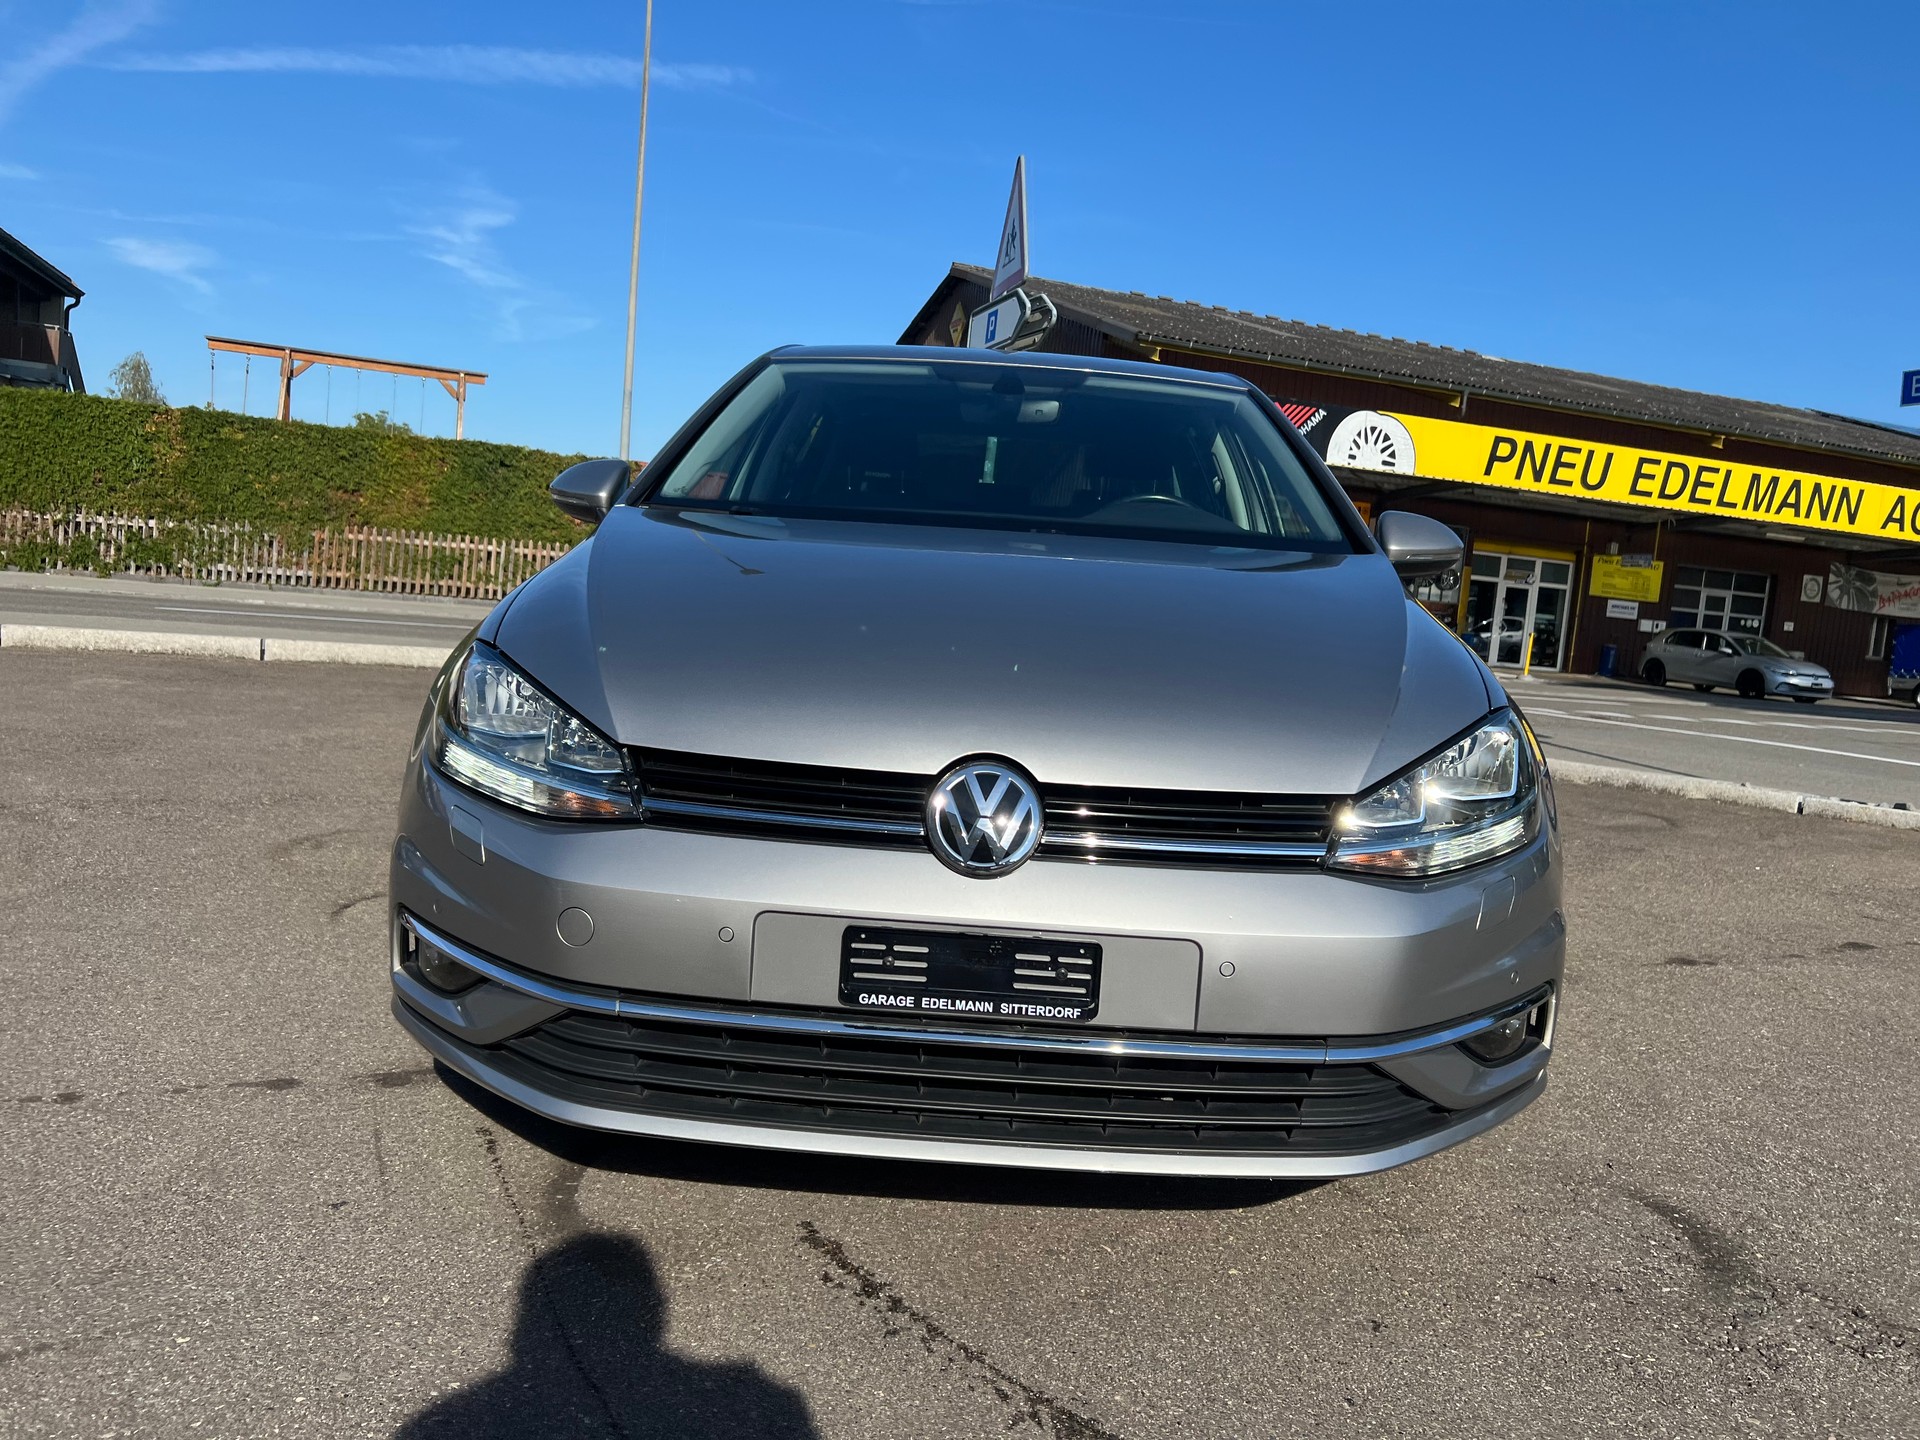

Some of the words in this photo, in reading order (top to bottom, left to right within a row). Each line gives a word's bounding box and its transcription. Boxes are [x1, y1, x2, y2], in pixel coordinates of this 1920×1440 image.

[987, 315, 996, 340] P
[1298, 408, 1327, 436] HAMA
[1483, 435, 1615, 491] PNEU
[1628, 456, 1866, 526] EDELMANN
[858, 993, 915, 1008] GARAGE
[921, 998, 994, 1013] EDELMANN
[1000, 1003, 1082, 1019] SITTERDORF
